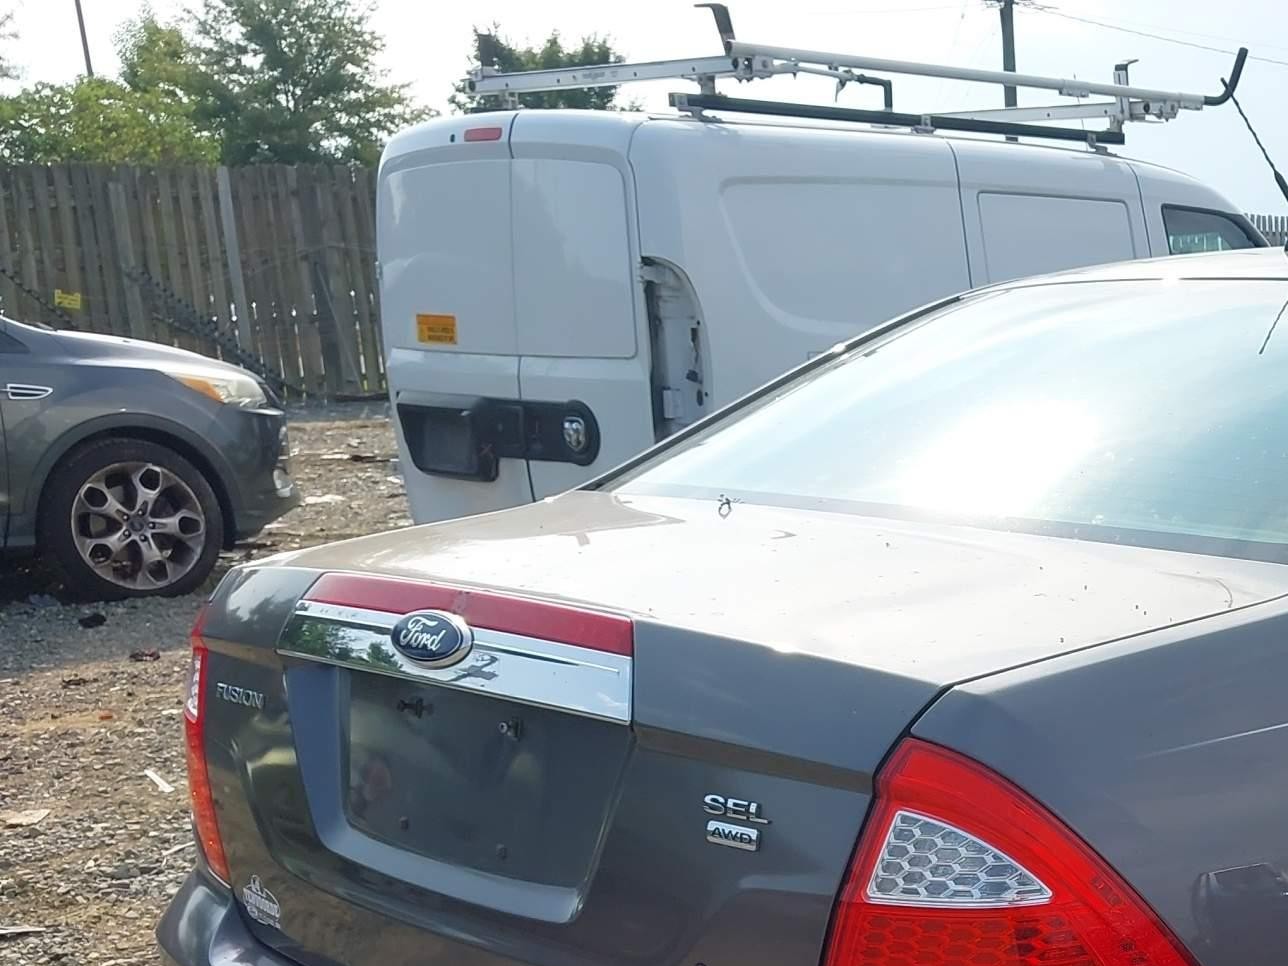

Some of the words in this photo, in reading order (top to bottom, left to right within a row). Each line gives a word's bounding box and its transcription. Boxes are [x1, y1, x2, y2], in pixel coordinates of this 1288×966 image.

[400, 616, 446, 651] Ford
[216, 682, 264, 709] FUSION
[703, 794, 768, 824] SEL
[711, 826, 752, 844] AWD
